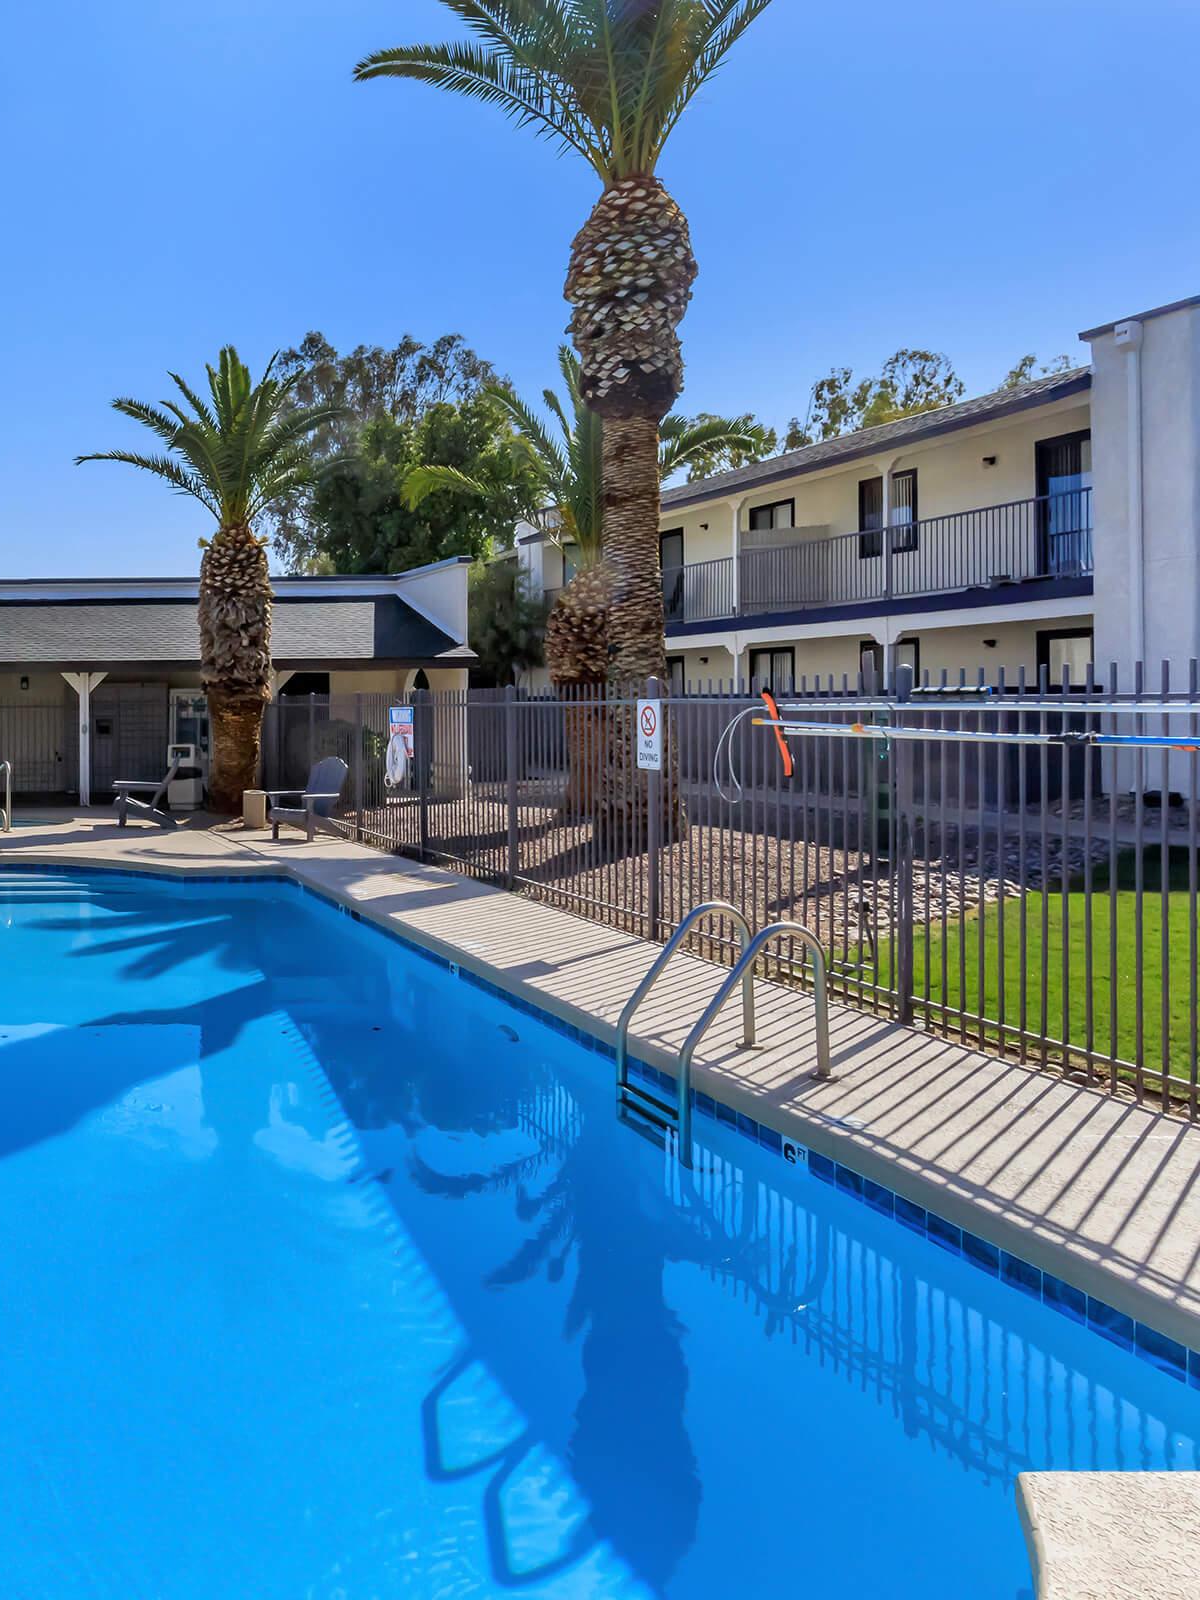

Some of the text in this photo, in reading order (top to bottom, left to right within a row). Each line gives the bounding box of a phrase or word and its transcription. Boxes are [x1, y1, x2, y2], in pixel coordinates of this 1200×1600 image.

[644, 739, 653, 749] NO
[639, 752, 659, 763] DIVING
[797, 1147, 806, 1161] FT
